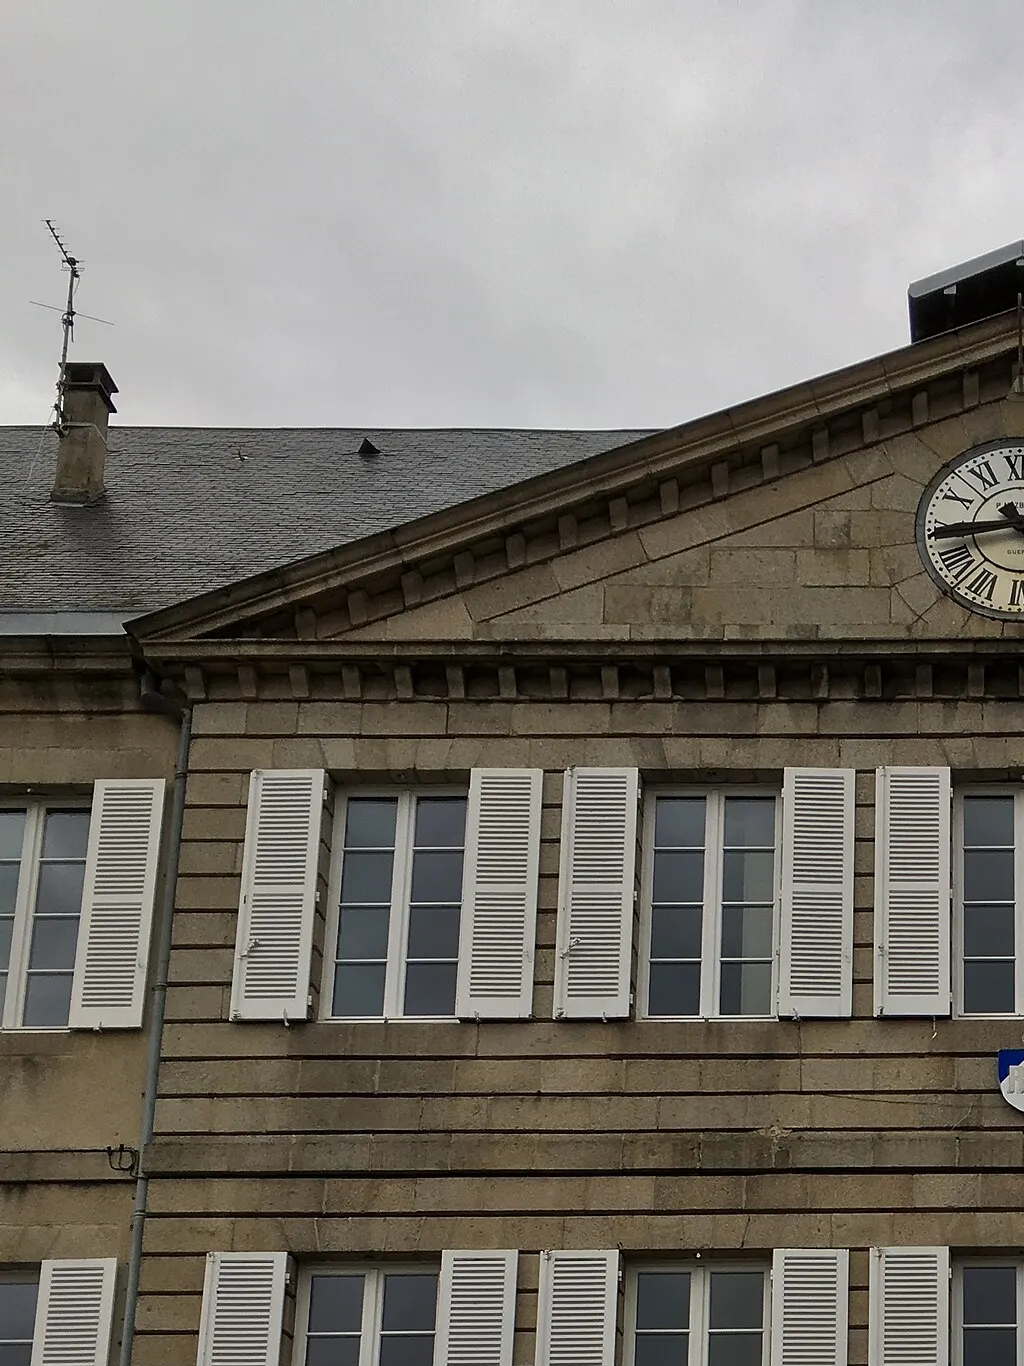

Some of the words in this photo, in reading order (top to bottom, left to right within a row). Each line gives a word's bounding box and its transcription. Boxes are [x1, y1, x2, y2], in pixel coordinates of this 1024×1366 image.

[967, 460, 1000, 491] XI
[942, 486, 975, 511] X
[965, 567, 998, 602] VII
